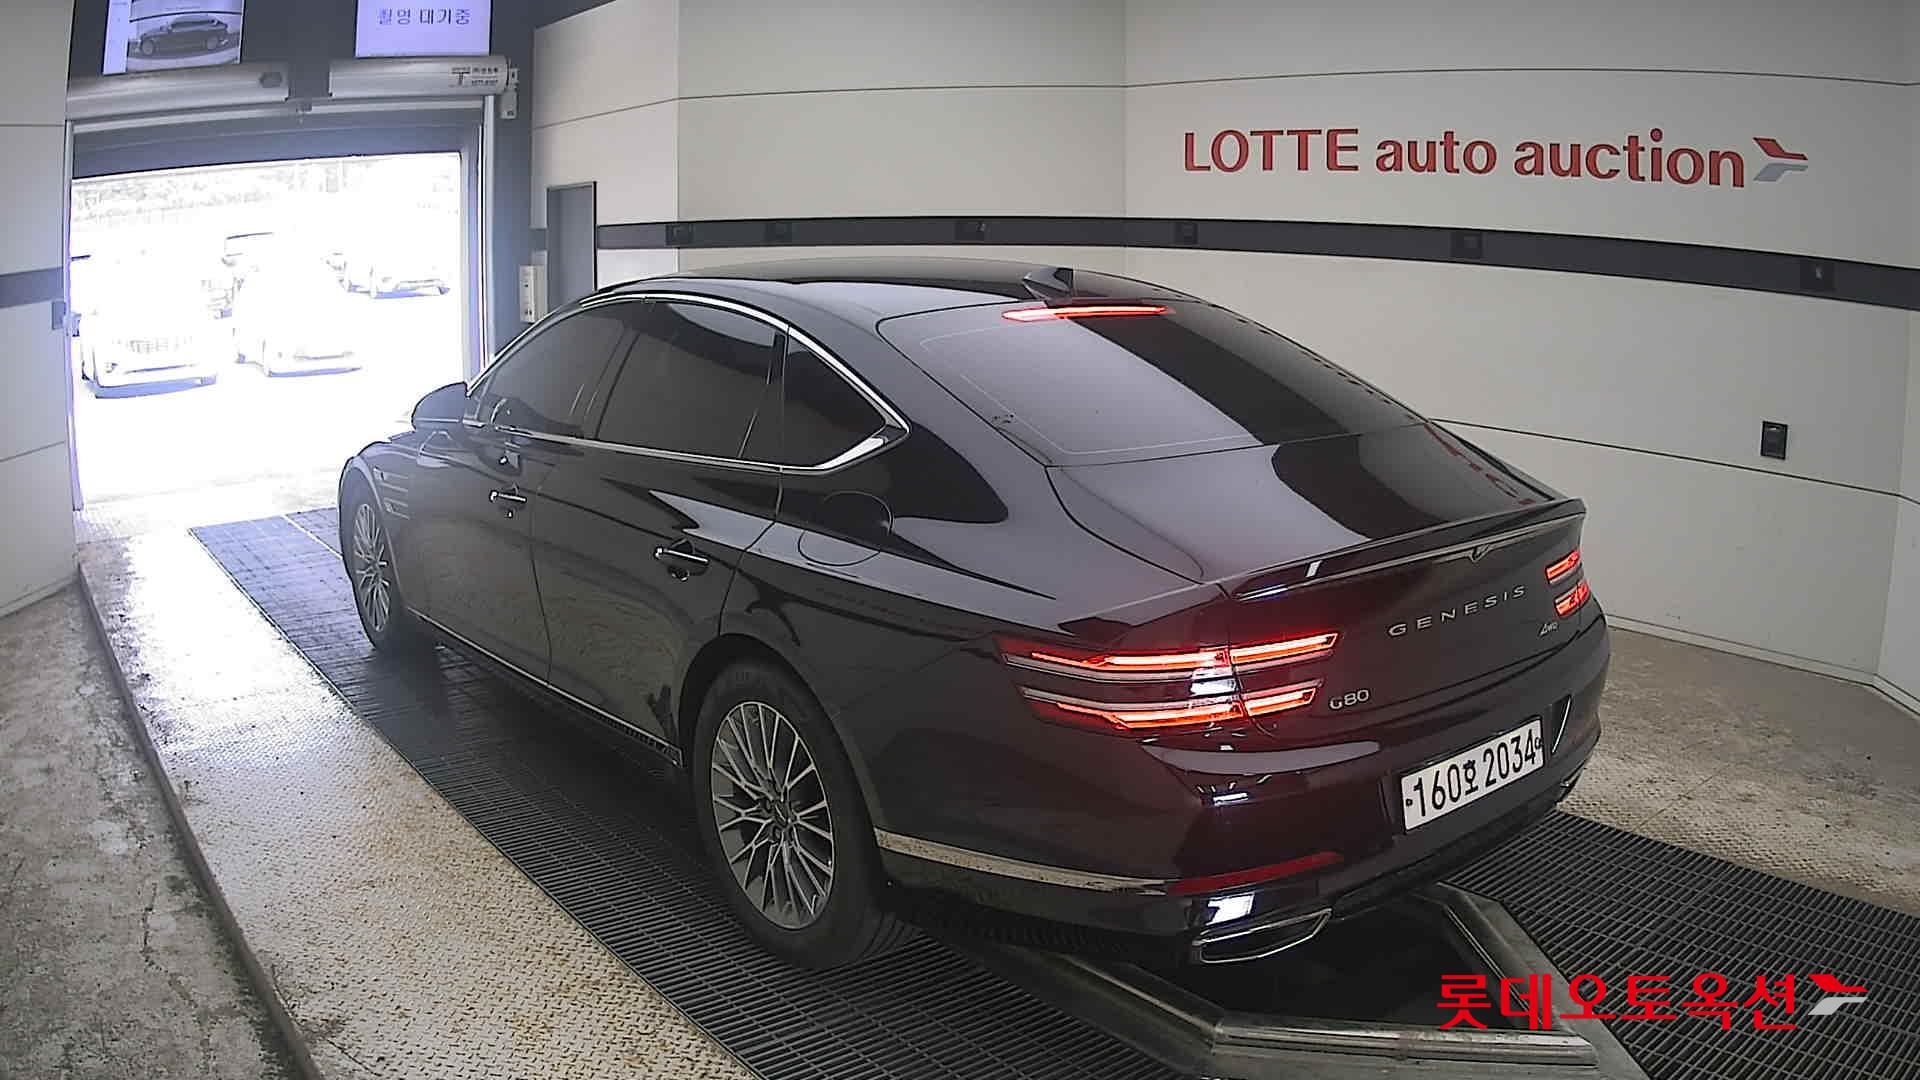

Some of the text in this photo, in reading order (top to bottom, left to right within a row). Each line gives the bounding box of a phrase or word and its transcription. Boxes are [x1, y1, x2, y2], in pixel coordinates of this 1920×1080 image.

[419, 8, 471, 25] 대기중
[1184, 127, 1745, 188] LOTTE auto auction
[1388, 585, 1525, 637] GENESIS
[1329, 689, 1370, 710] G80
[1413, 729, 1536, 817] 160호 2034
